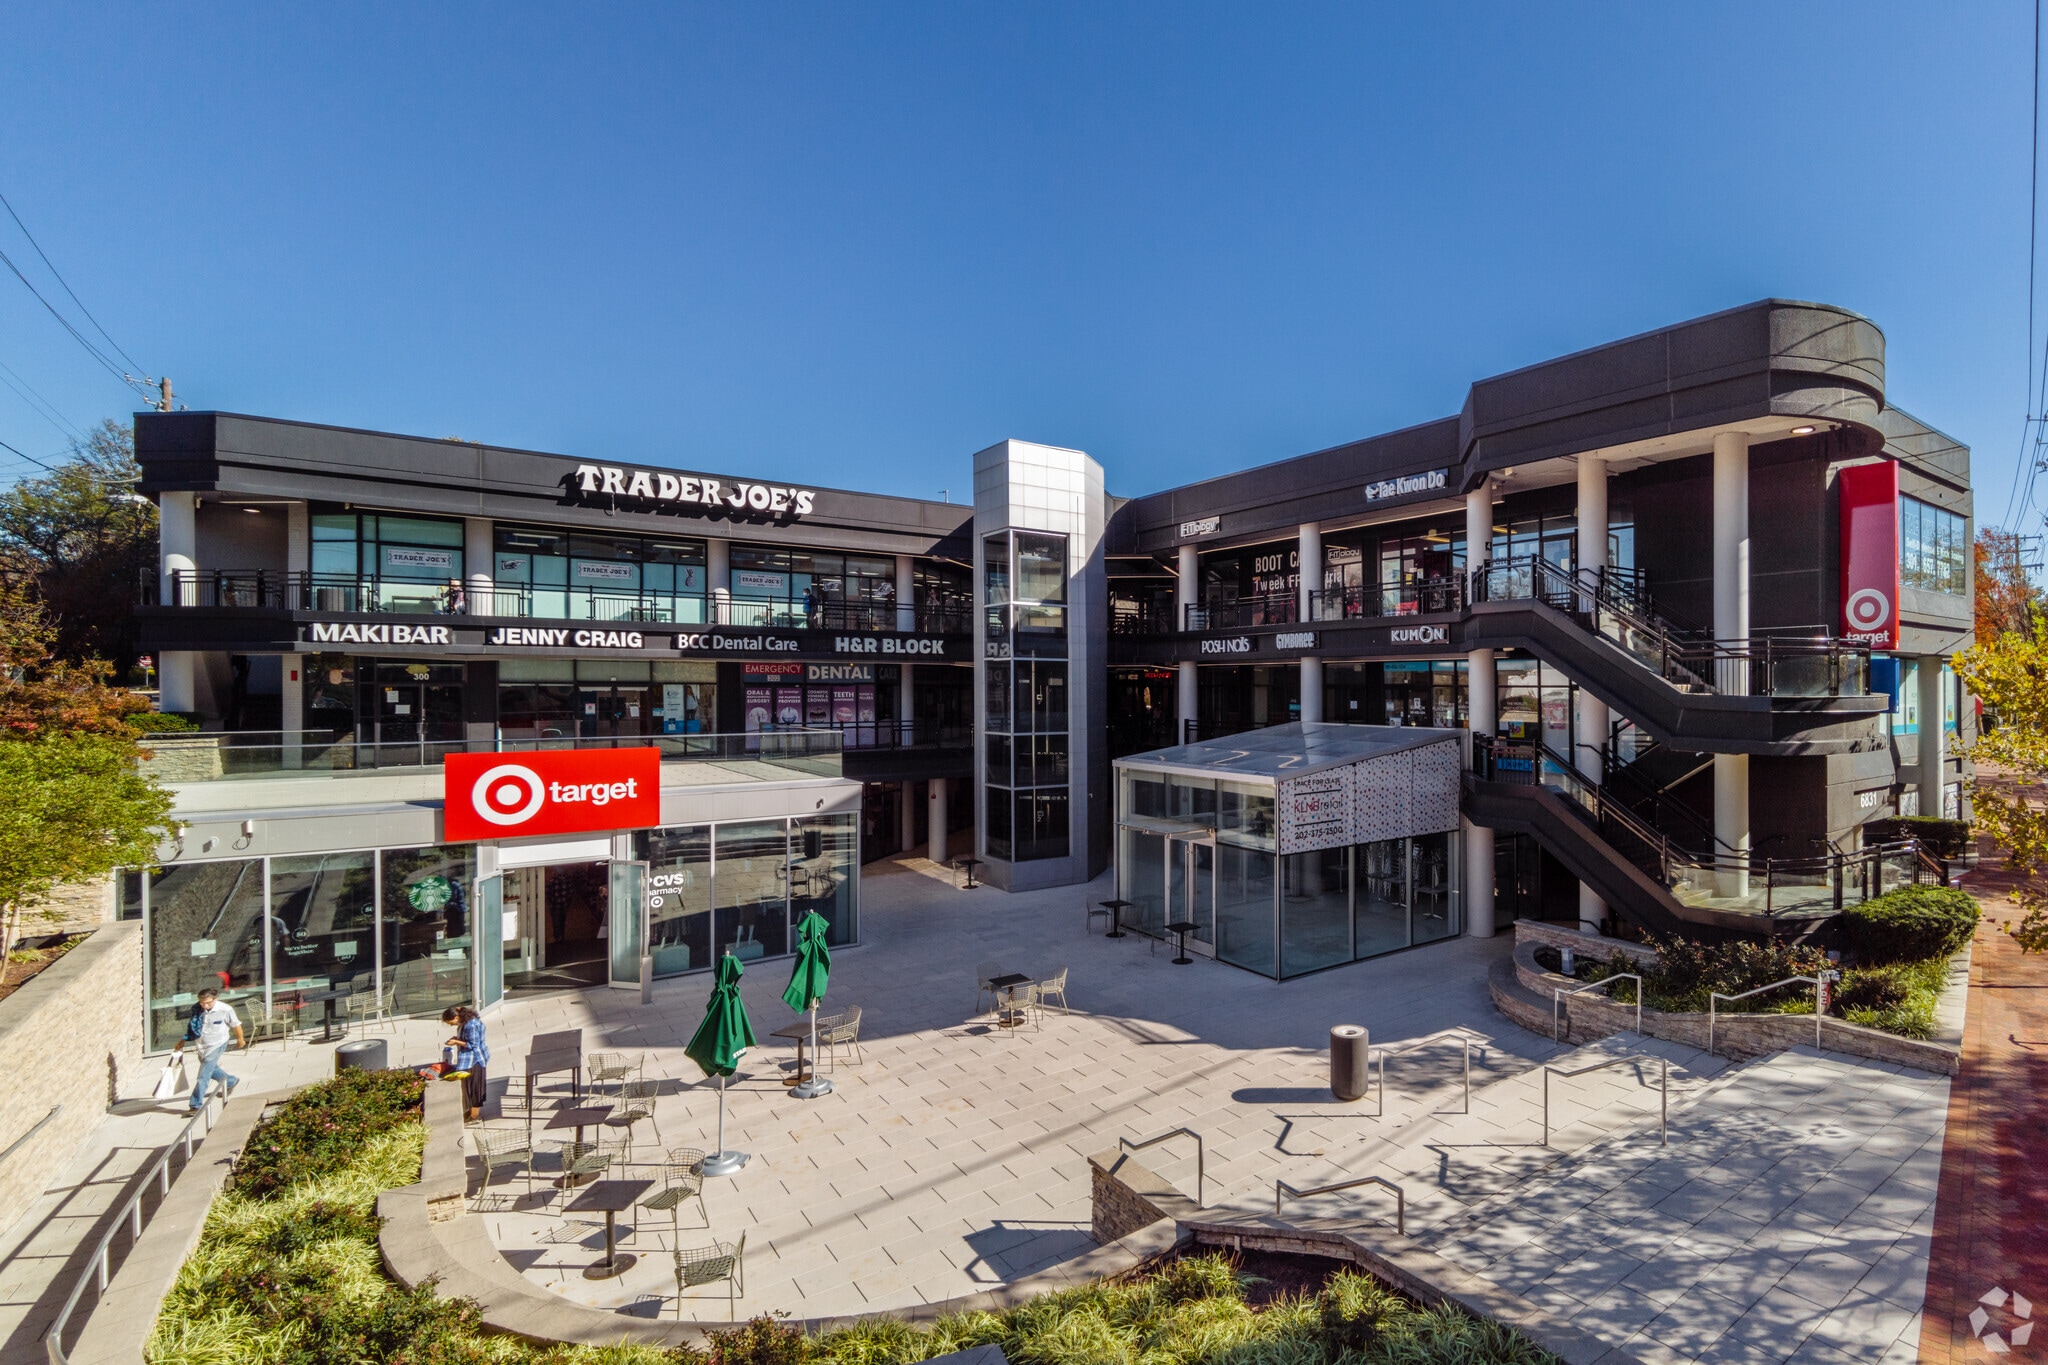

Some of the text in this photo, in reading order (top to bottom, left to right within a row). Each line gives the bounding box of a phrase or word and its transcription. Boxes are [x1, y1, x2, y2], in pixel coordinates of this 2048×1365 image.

[576, 465, 815, 514] TRADER JOE'S
[1378, 471, 1445, 498] Tae Kwon Do
[393, 554, 446, 564] TRADER JOE'S
[1255, 551, 1300, 573] BOOT CA
[582, 566, 608, 574] TRADER
[1260, 577, 1285, 590] week
[1288, 574, 1300, 588] FR
[493, 627, 642, 648] JENNY CRAIG
[678, 634, 709, 649] BCC
[713, 635, 762, 650] Dental
[1391, 626, 1444, 643] KUMON
[1846, 630, 1889, 645] target
[836, 637, 944, 654] H&R BLOCK
[1201, 640, 1225, 653] POSH
[745, 664, 801, 673] EMERGENCY
[808, 666, 871, 680] DENTAL
[879, 667, 898, 680] CARE
[549, 778, 637, 806] target
[653, 873, 684, 887] CVS
